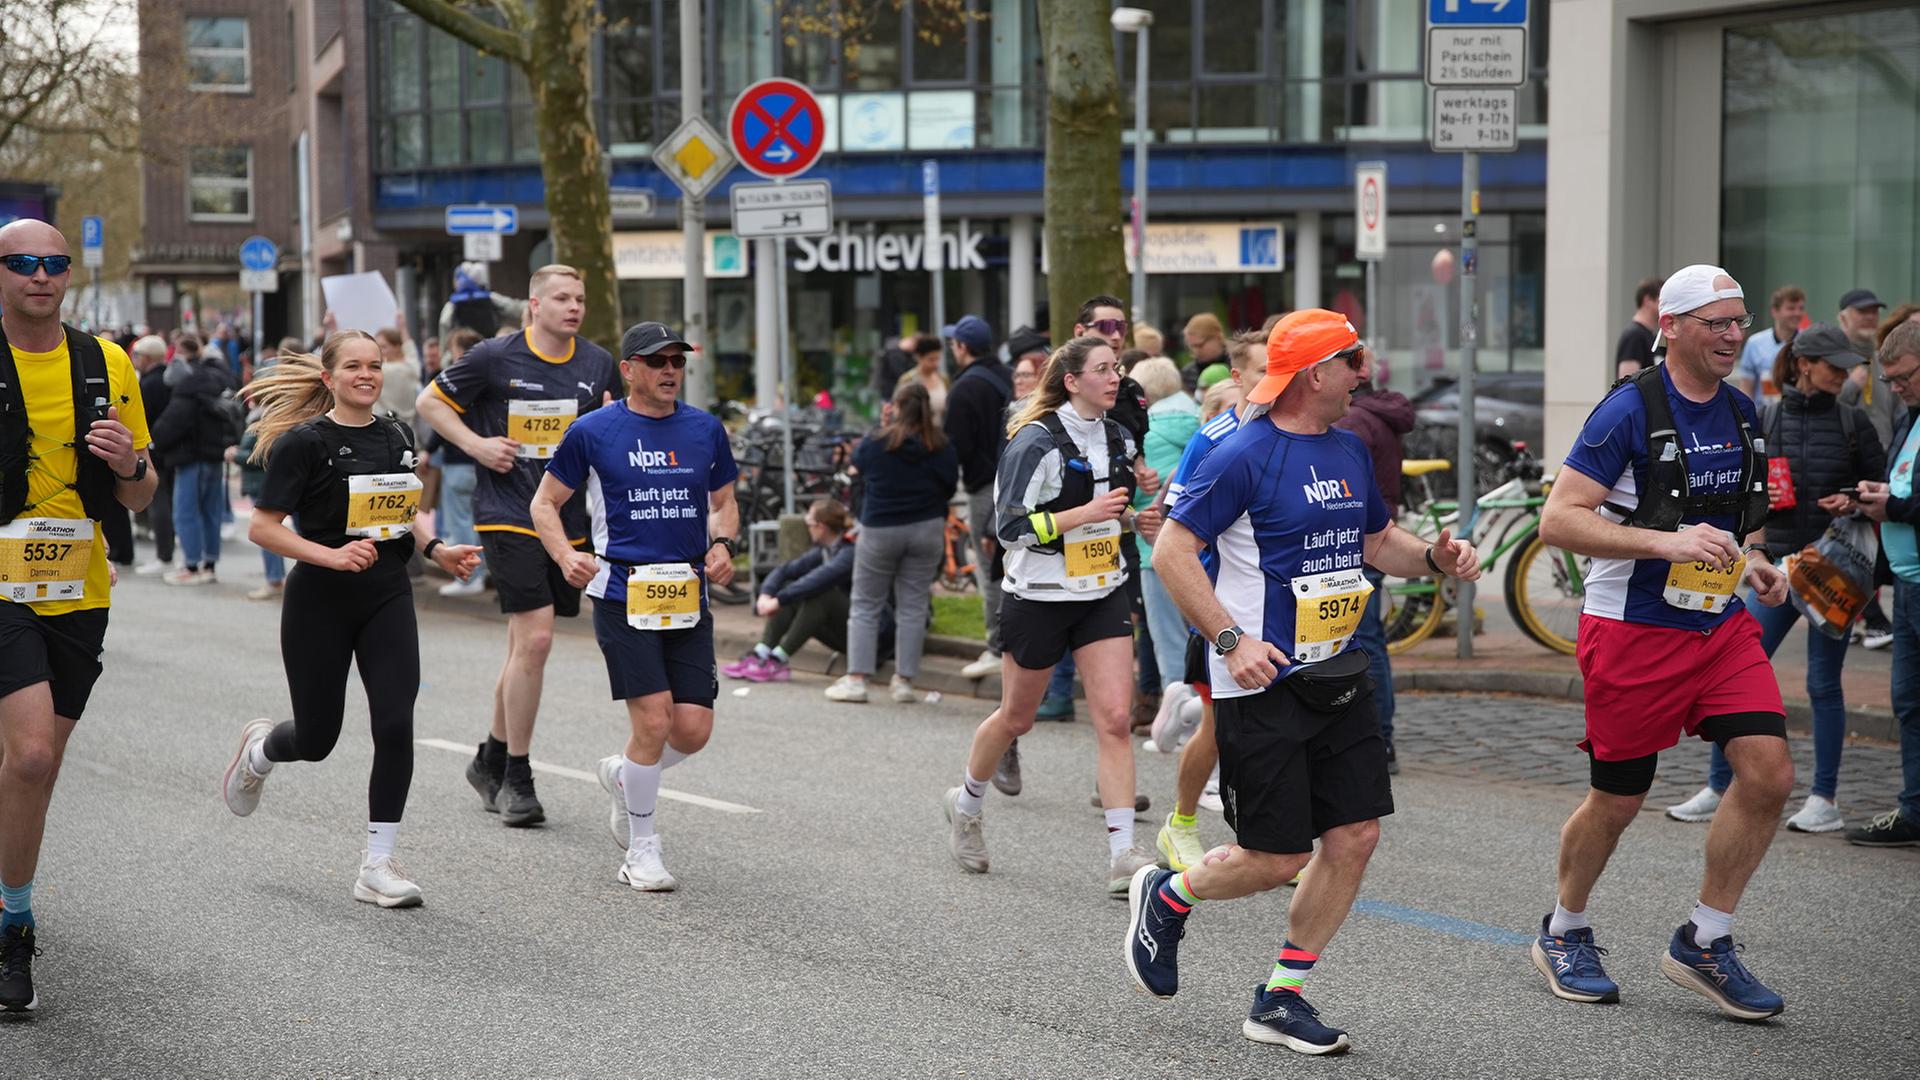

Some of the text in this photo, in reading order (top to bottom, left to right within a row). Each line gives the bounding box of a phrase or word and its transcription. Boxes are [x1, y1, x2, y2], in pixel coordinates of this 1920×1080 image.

[1453, 35, 1502, 46] nur mit
[1442, 50, 1512, 62] Parkschein
[1461, 65, 1512, 78] Stunden
[1442, 97, 1507, 110] werktags
[1440, 112, 1472, 125] Mo-Fr
[1440, 129, 1452, 141] Sa
[794, 217, 985, 272] Schievnk
[523, 418, 560, 431] 4782
[628, 450, 678, 467] NDR 1
[647, 467, 694, 475] Niedersachsen
[1688, 466, 1742, 488] äuft jetzt
[628, 487, 689, 504] Läuft jetzt
[1303, 478, 1352, 504] NDR 1
[368, 494, 406, 511] 1762
[630, 505, 659, 520] auch
[661, 505, 680, 519] bei
[1303, 527, 1360, 551] Läuft jetzt
[23, 543, 72, 562] 5537
[1082, 540, 1113, 559] 1590
[1302, 554, 1332, 573] auch
[1334, 551, 1352, 570] bei
[30, 568, 60, 577] Damian
[1327, 579, 1358, 588] MARATHON
[646, 584, 688, 599] 5994
[1319, 596, 1360, 620] 5974
[1329, 624, 1348, 634] Frank
